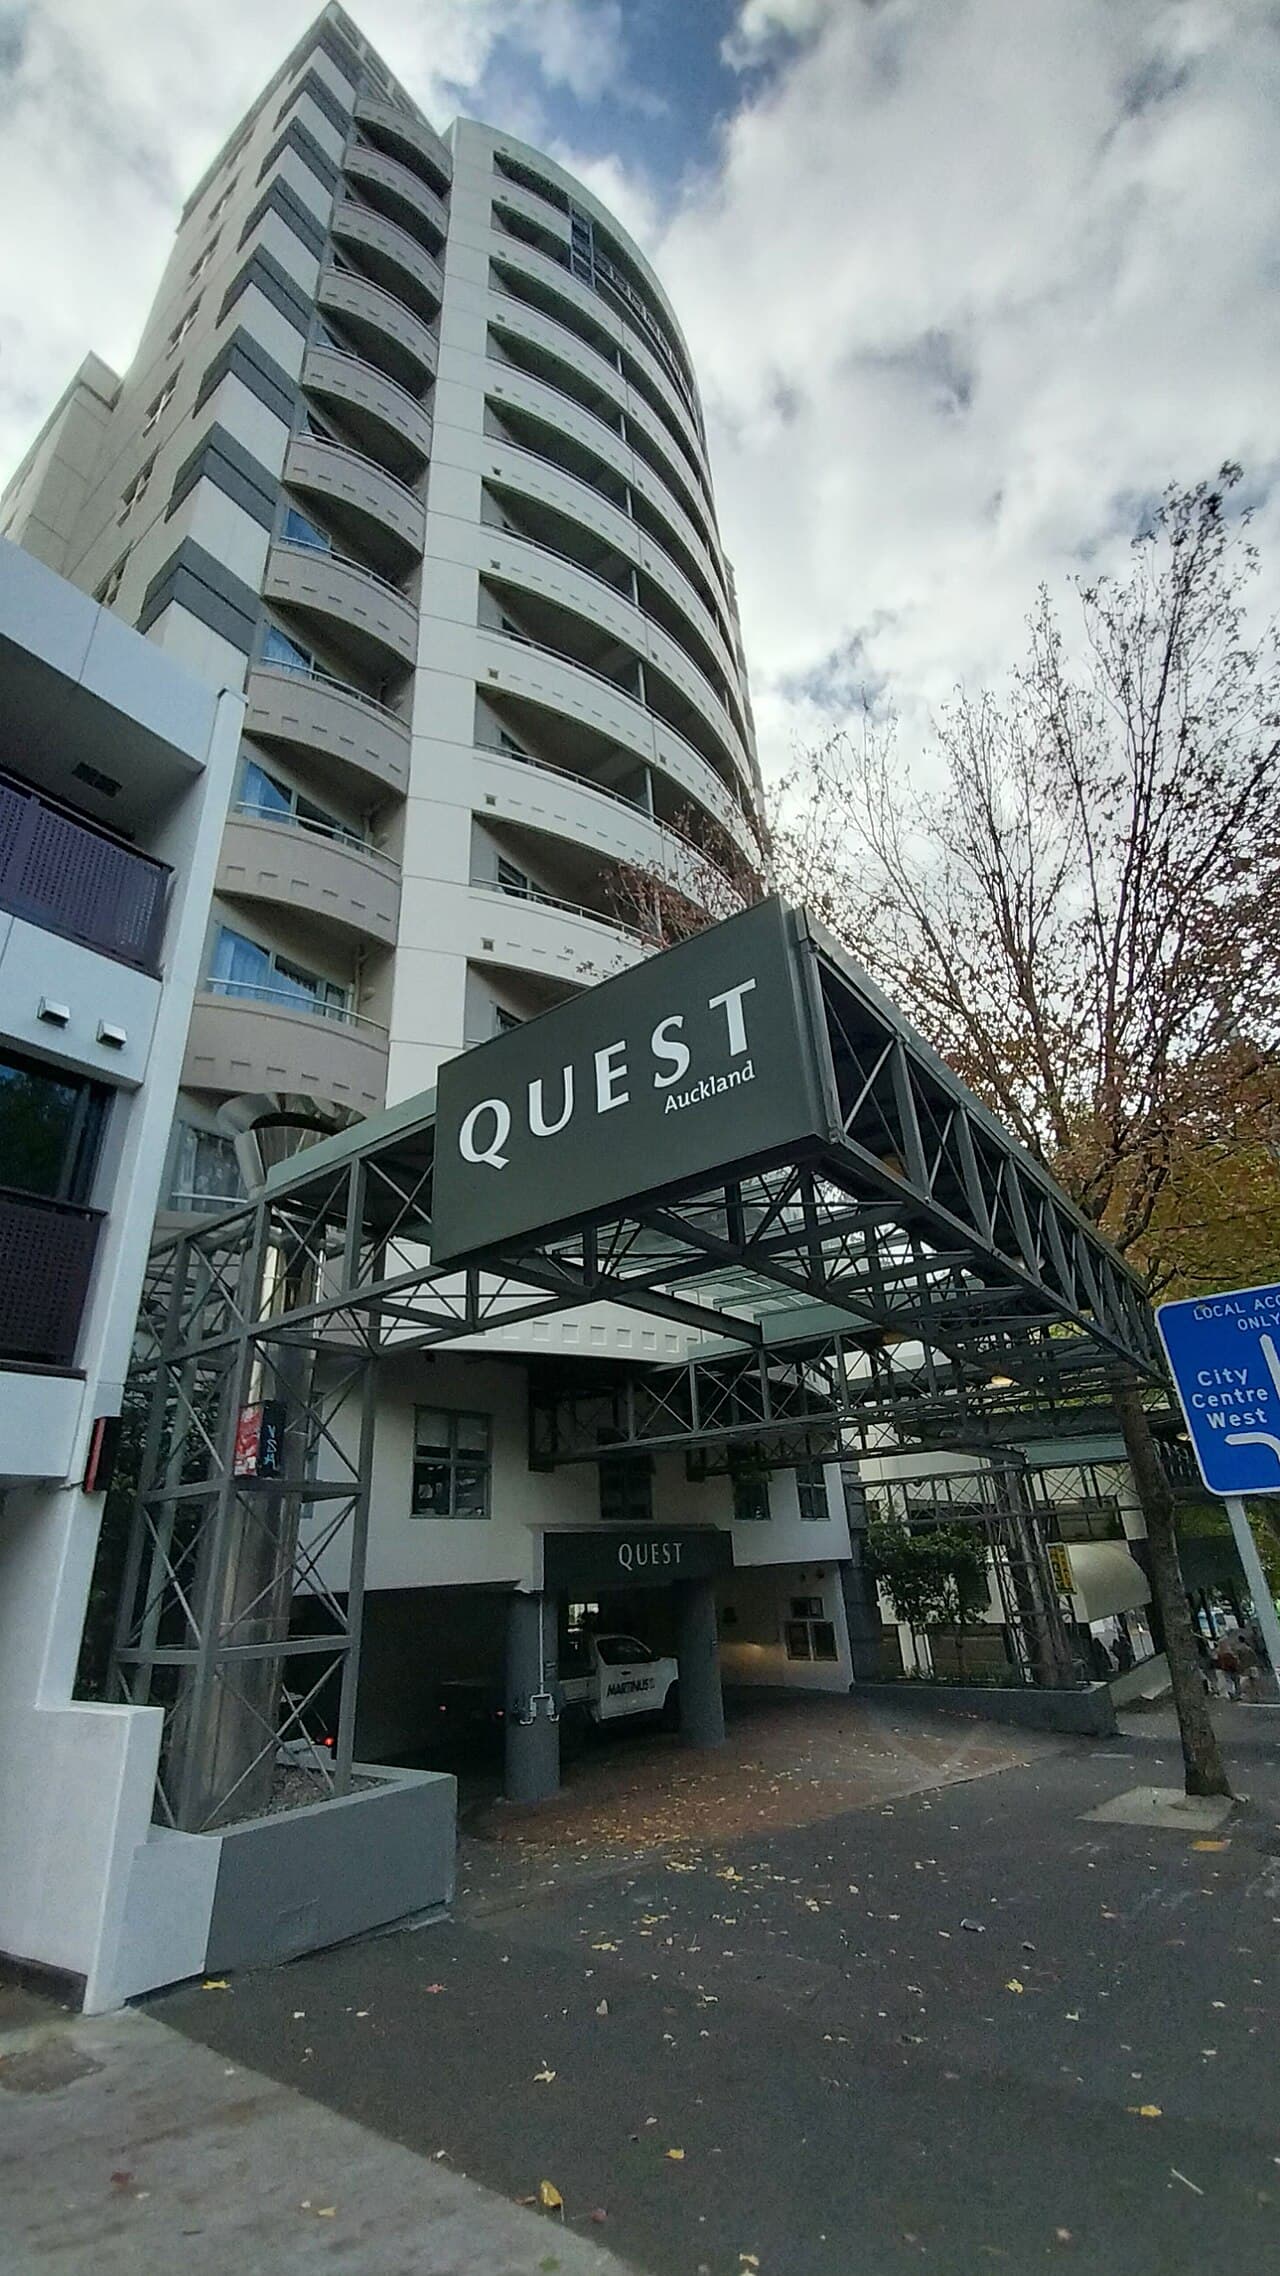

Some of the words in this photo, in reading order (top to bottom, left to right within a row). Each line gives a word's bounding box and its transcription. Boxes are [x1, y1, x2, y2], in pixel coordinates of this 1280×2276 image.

[459, 978, 757, 1170] QUEST
[664, 1061, 756, 1114] Auckland
[1193, 1302, 1246, 1321] LOCAL
[1237, 1312, 1280, 1331] ONLY
[1197, 1368, 1248, 1386] City
[1192, 1388, 1269, 1409] Centre
[1206, 1407, 1267, 1429] West
[618, 1542, 684, 1571] QUEST
